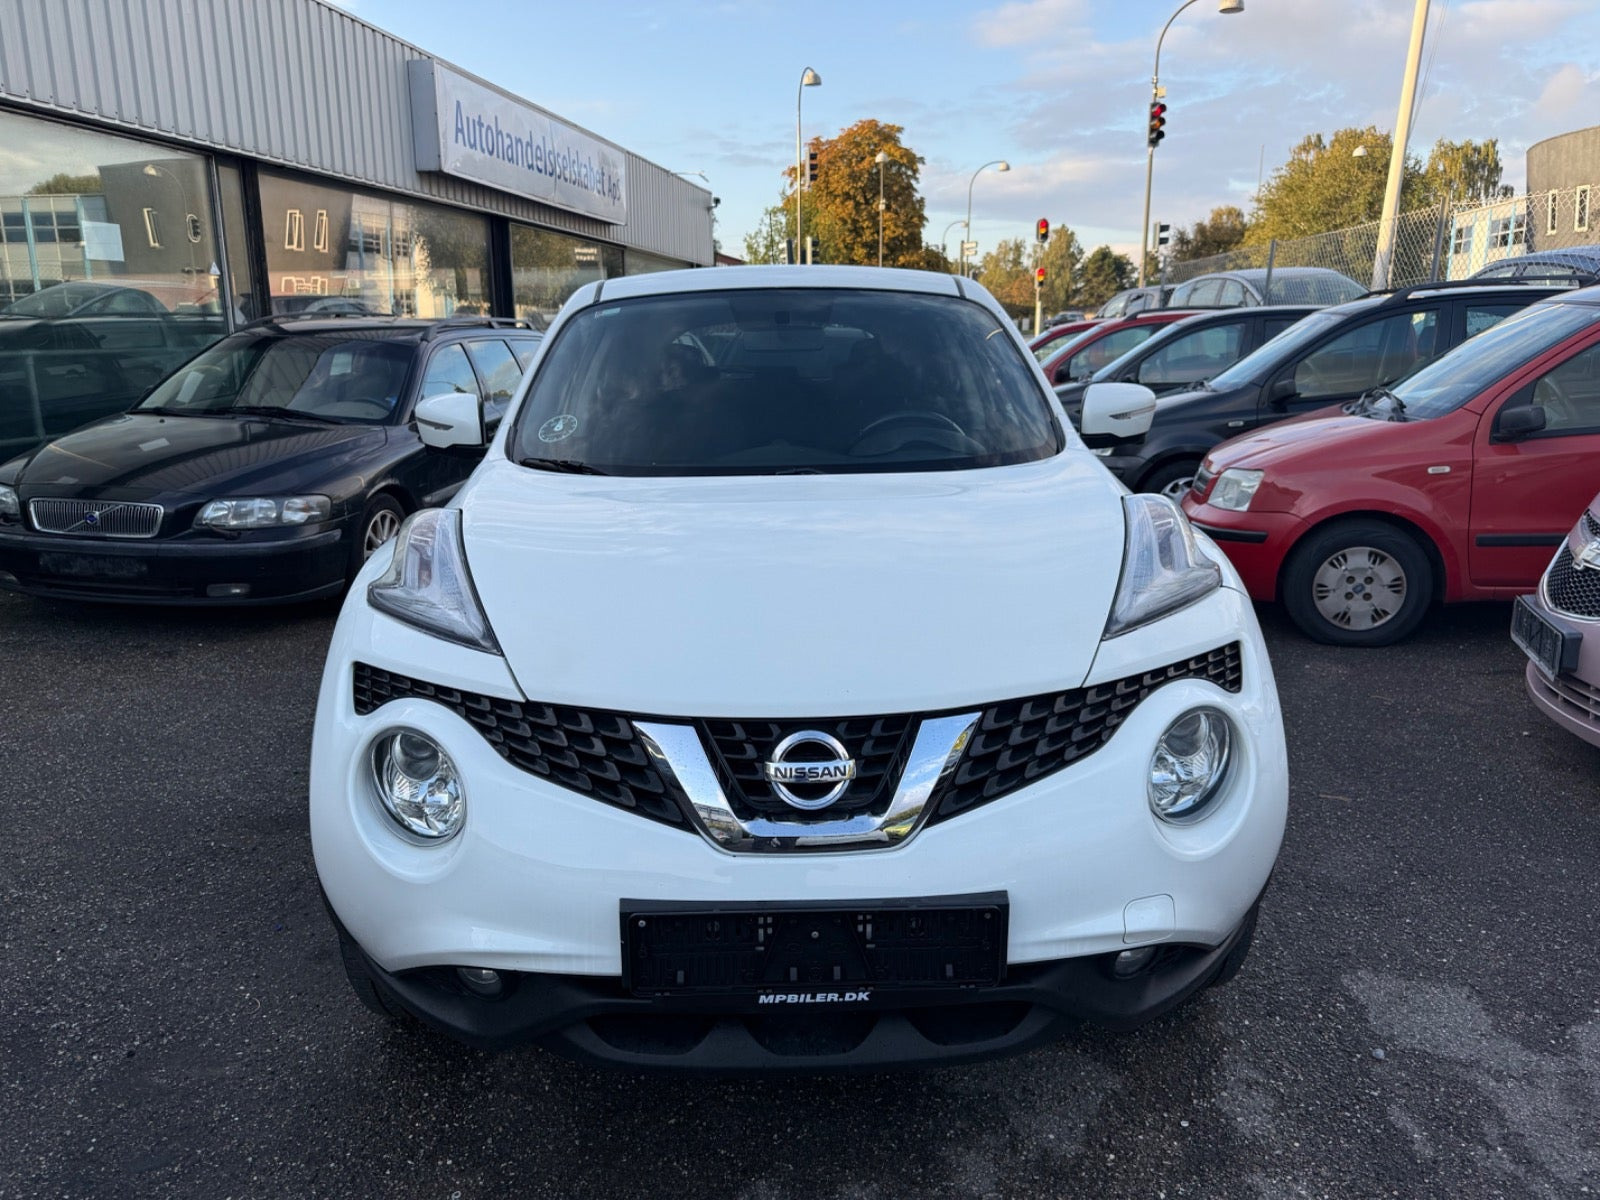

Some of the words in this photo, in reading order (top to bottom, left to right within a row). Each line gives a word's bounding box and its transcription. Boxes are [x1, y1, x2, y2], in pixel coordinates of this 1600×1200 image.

[455, 100, 606, 197] Autohandelsselskabet
[774, 765, 847, 779] NISSAN
[759, 992, 871, 1004] MPBILER.DK
